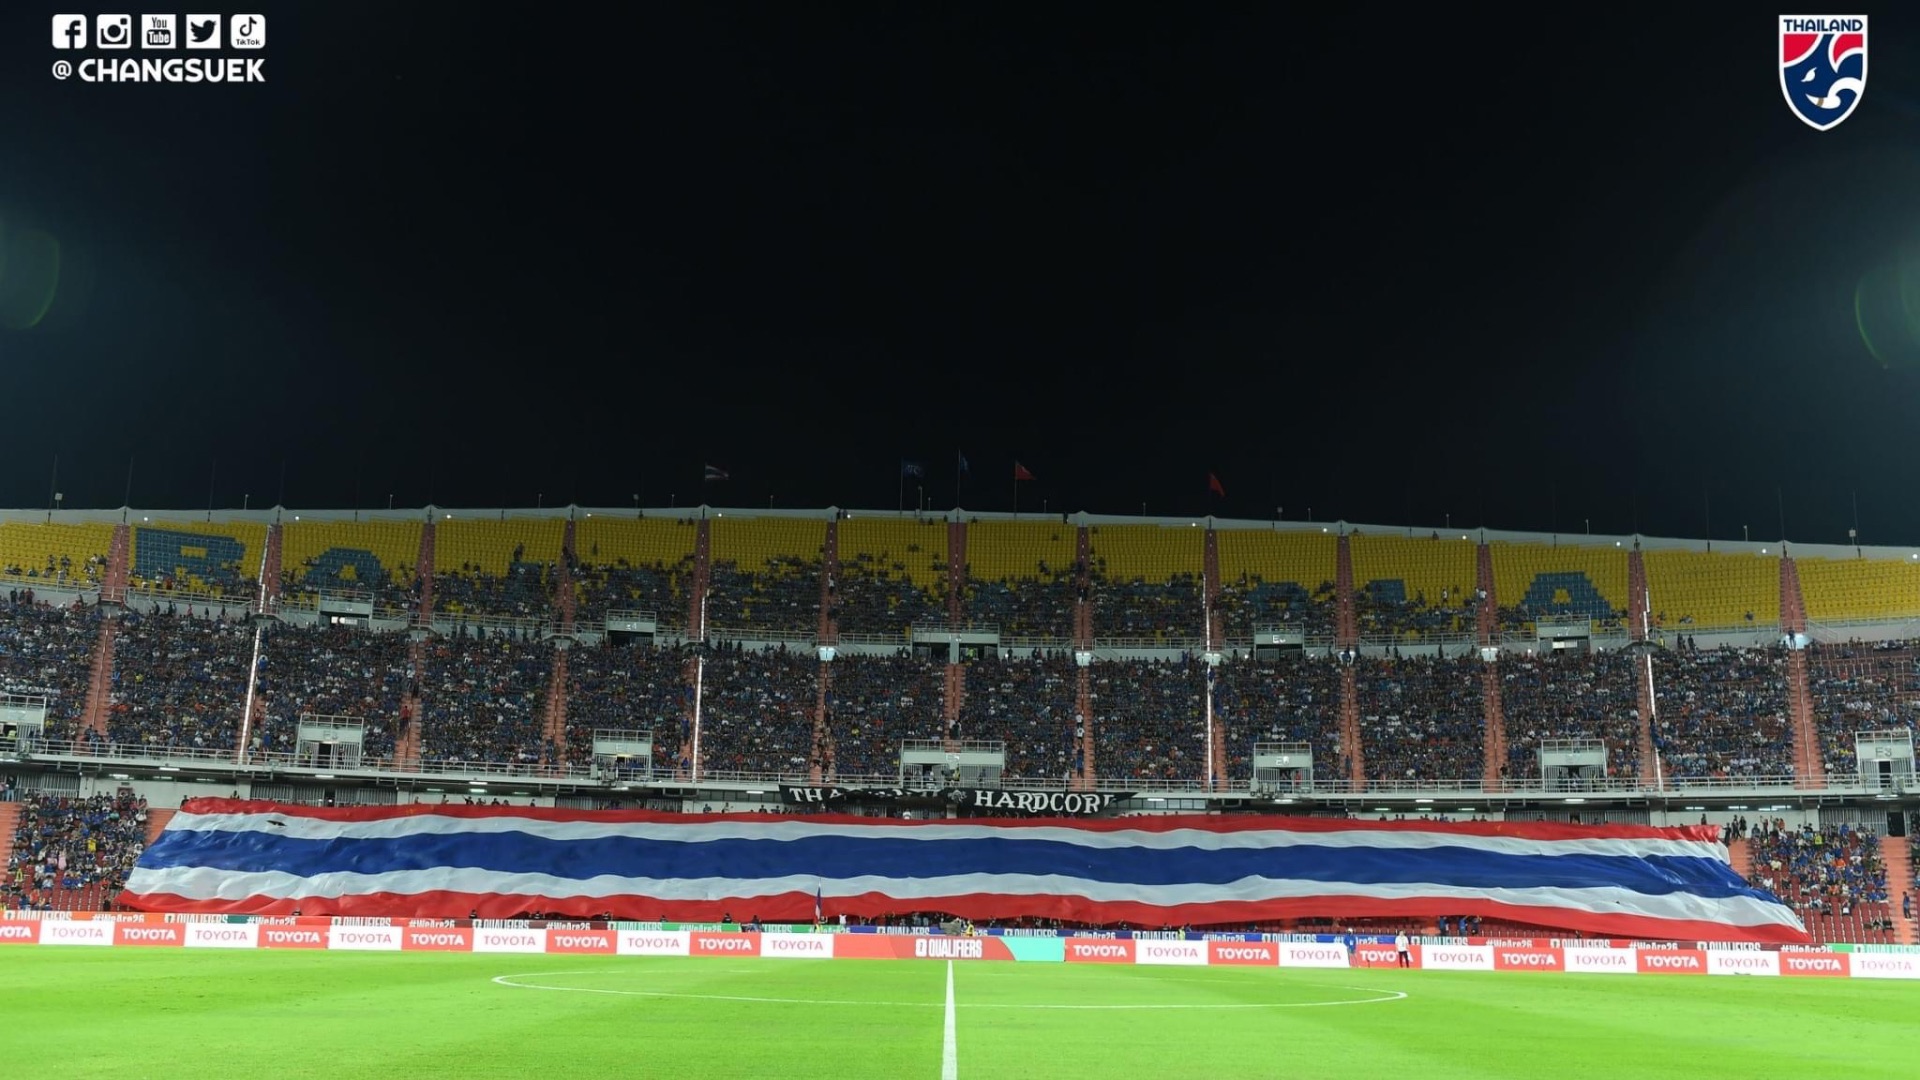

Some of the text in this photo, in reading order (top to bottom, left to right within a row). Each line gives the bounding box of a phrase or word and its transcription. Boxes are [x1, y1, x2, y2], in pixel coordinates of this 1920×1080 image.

[0, 926, 32, 938] YOTA
[52, 927, 103, 938] TOYOTA
[123, 928, 176, 940] TOYOTA
[195, 929, 248, 941] TOYOTA
[266, 930, 320, 943] TOYOTA
[339, 932, 392, 943] TOYOTA
[410, 933, 464, 945] TOYOTA
[484, 935, 536, 946] TOYOTA
[555, 935, 608, 948] TOYOTA
[628, 937, 680, 948] TOYOTA
[698, 937, 752, 950] TOYOTA
[771, 939, 823, 951] TOYOTA
[929, 938, 983, 958] QUALIFIERS
[1073, 945, 1127, 957] TOYOTA
[1146, 946, 1198, 957] TOYOTA
[1216, 947, 1271, 960] TOYOTA
[1290, 949, 1341, 960] TOYOTA
[1432, 951, 1484, 963] TOYOTA
[1502, 952, 1556, 965] TOYOTA
[1574, 955, 1627, 966] TOYOTA
[1644, 955, 1699, 968] TOYOTA
[1718, 957, 1770, 968] TOYOTA
[1787, 958, 1842, 971] TOYOTA
[1860, 960, 1912, 970] TOYOTA
